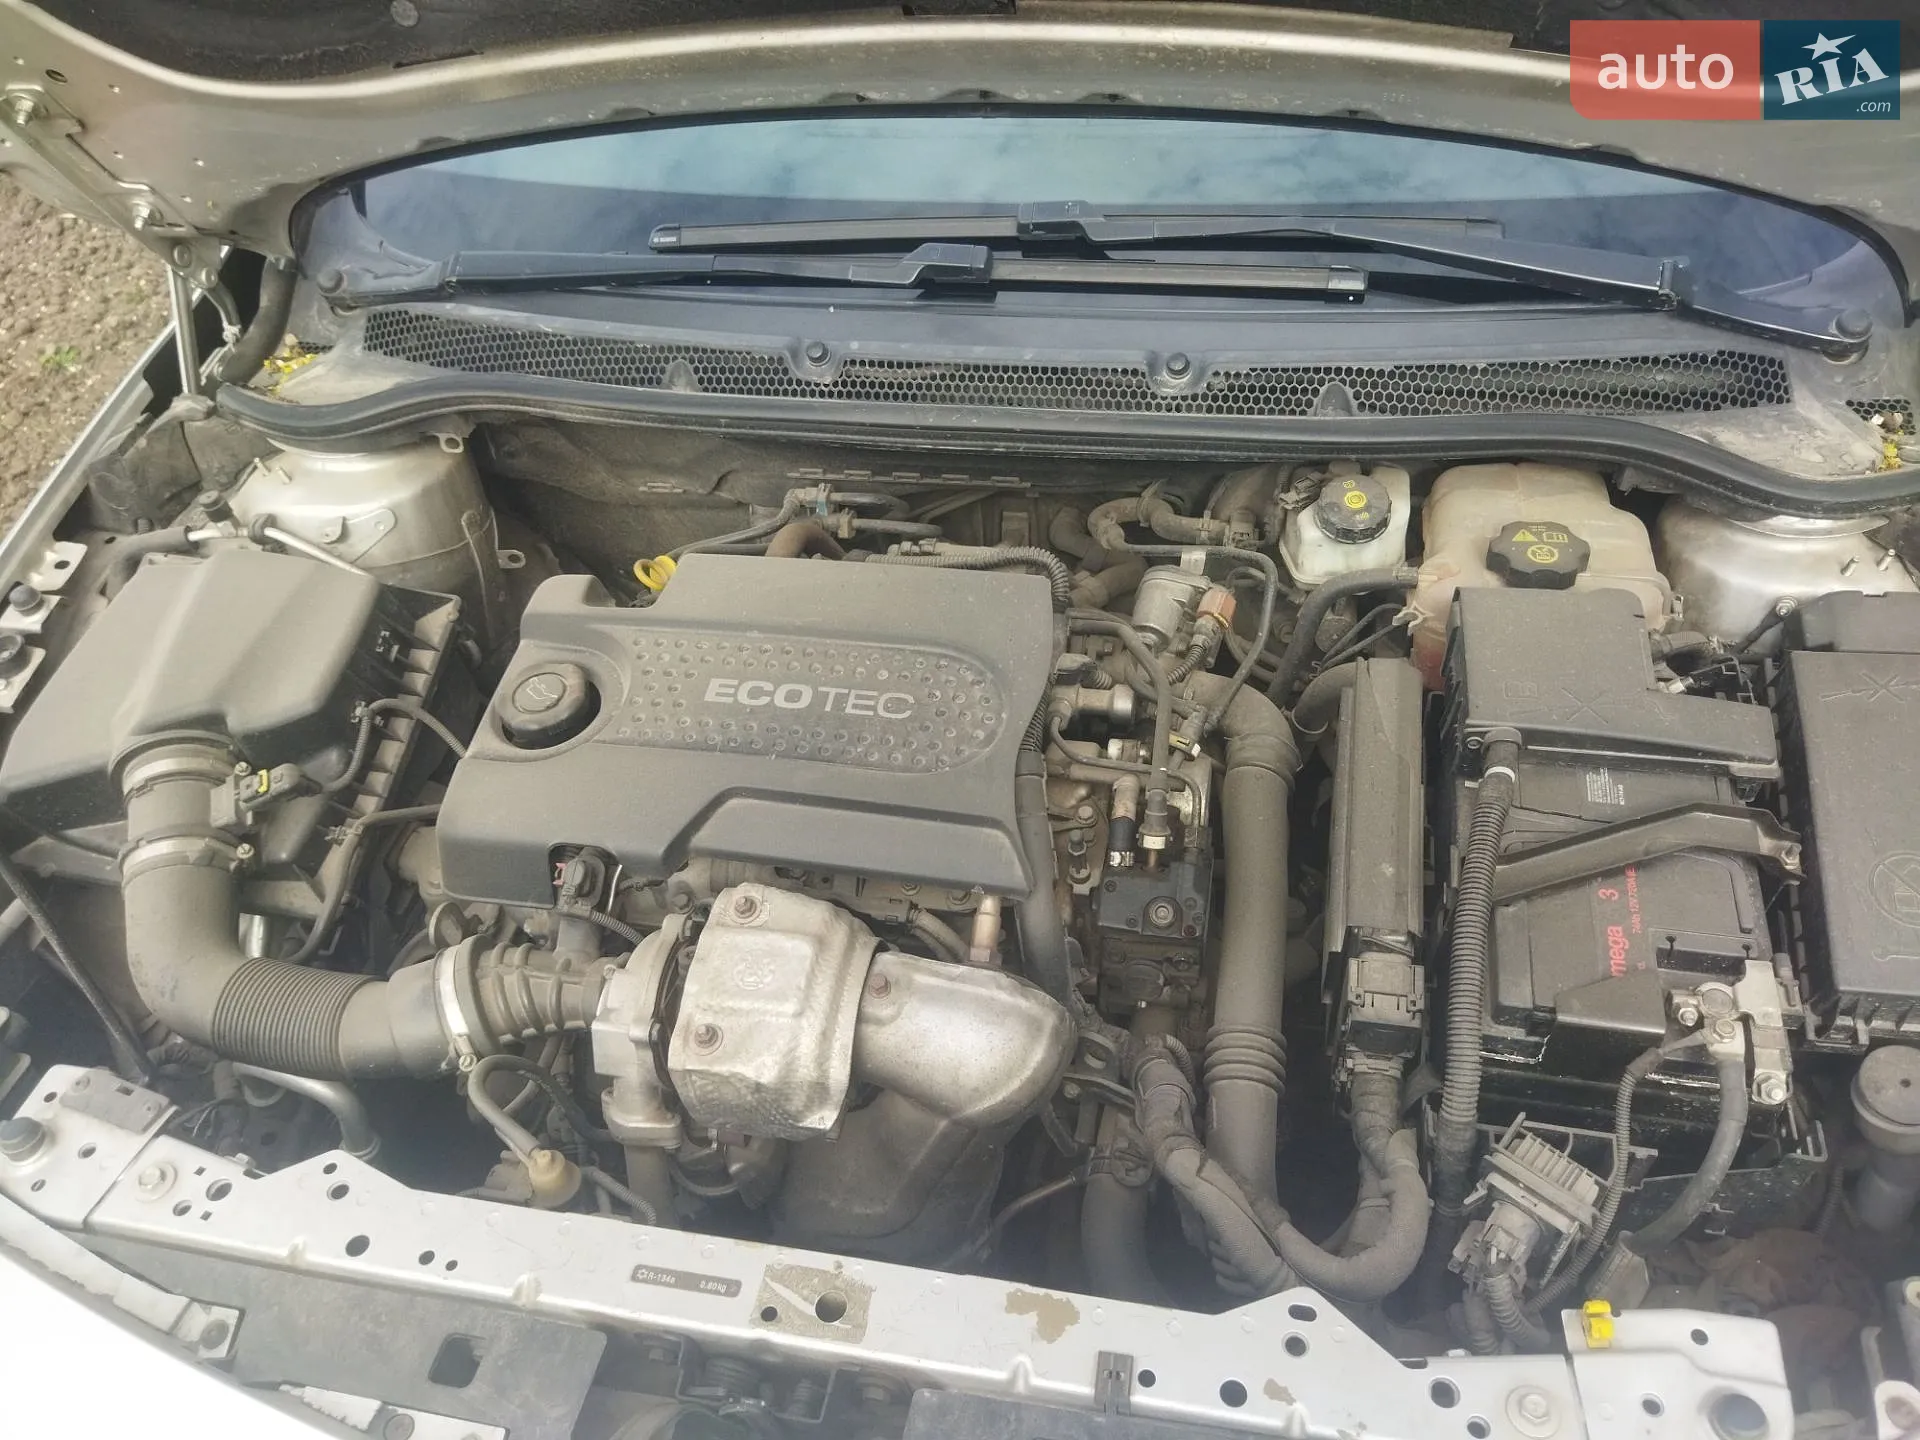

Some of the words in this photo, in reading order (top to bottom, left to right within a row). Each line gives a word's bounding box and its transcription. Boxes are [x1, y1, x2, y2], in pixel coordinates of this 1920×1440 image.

[704, 678, 915, 719] ECOTEC
[1598, 888, 1620, 901] 3
[1608, 925, 1630, 977] mega
[648, 1271, 676, 1284] R-134a
